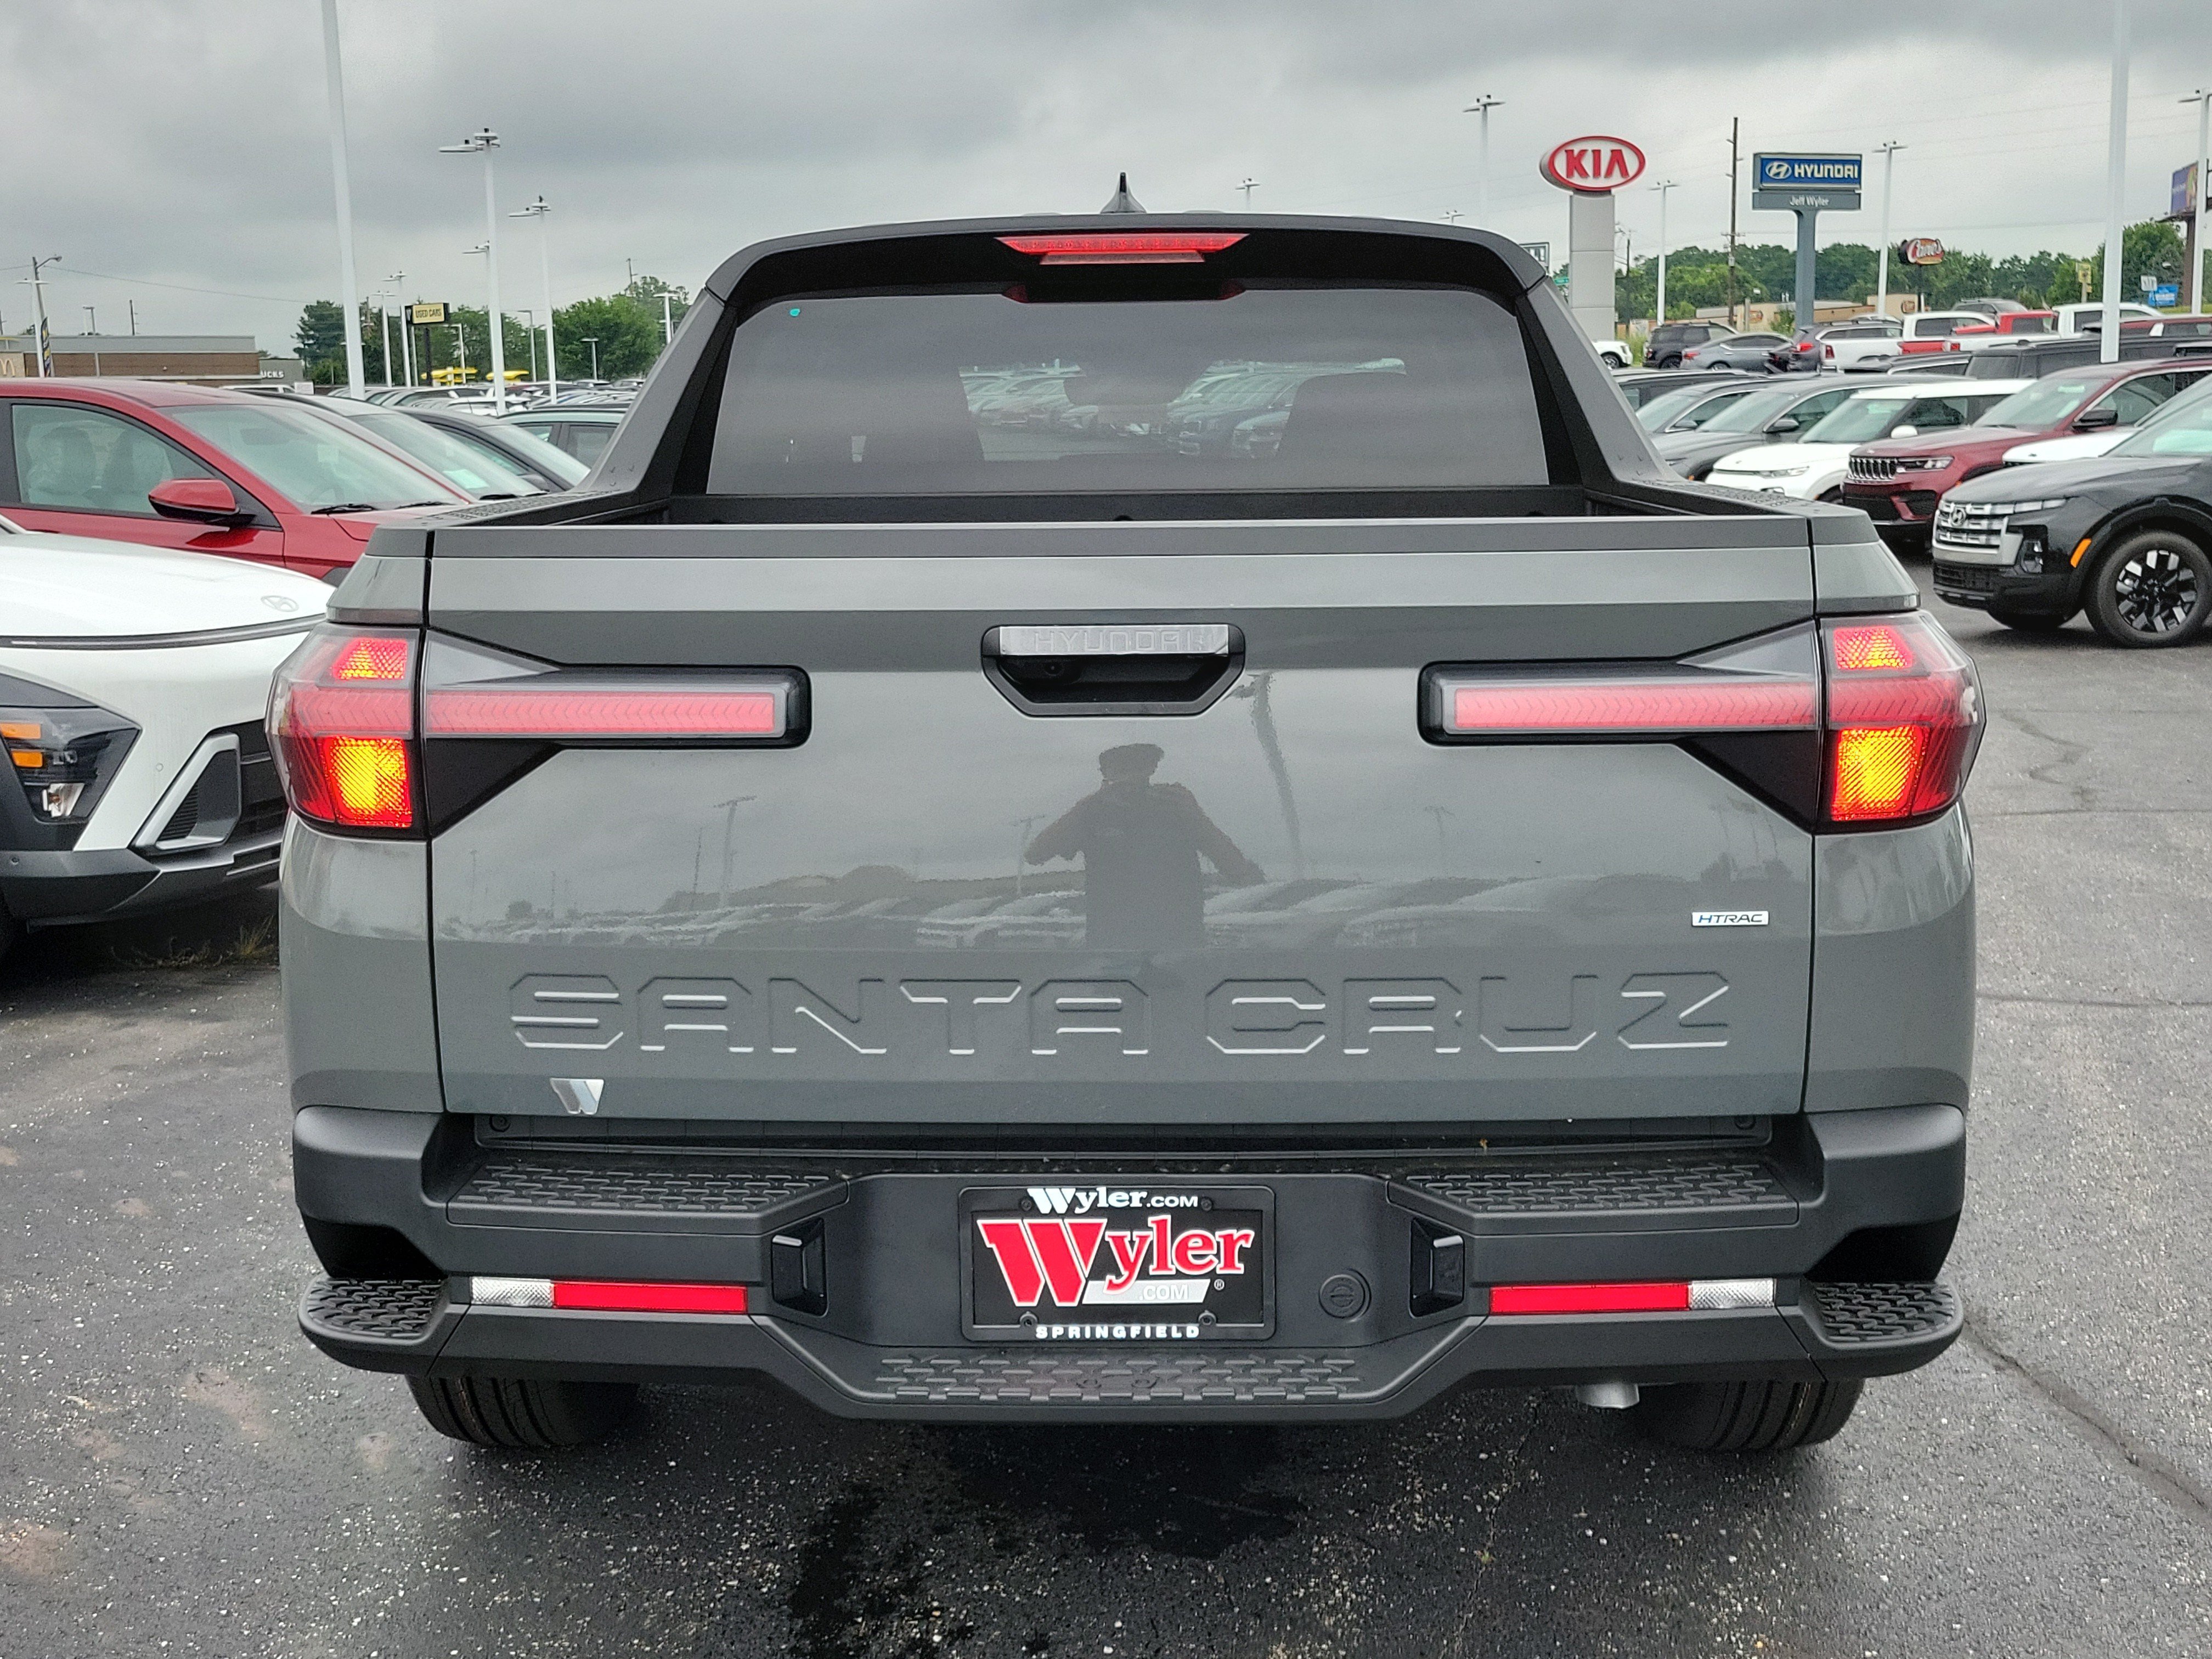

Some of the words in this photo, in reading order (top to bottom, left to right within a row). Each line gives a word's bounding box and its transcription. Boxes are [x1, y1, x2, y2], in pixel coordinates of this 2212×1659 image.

[1565, 149, 1629, 178] KIA
[1794, 163, 1859, 179] HYUNDAI
[1790, 195, 1805, 206] Jeff
[1806, 195, 1830, 207] Wyler
[415, 309, 428, 318] USED
[429, 308, 442, 317] CARS
[1034, 629, 1192, 652] HYUNDAI
[1698, 914, 1763, 923] HTRAC
[509, 973, 1150, 1056] SANTA
[1205, 970, 1730, 1054] CRUZ
[977, 1215, 1255, 1307] Wyler
[1035, 1325, 1200, 1339] SPRINGFIELD
